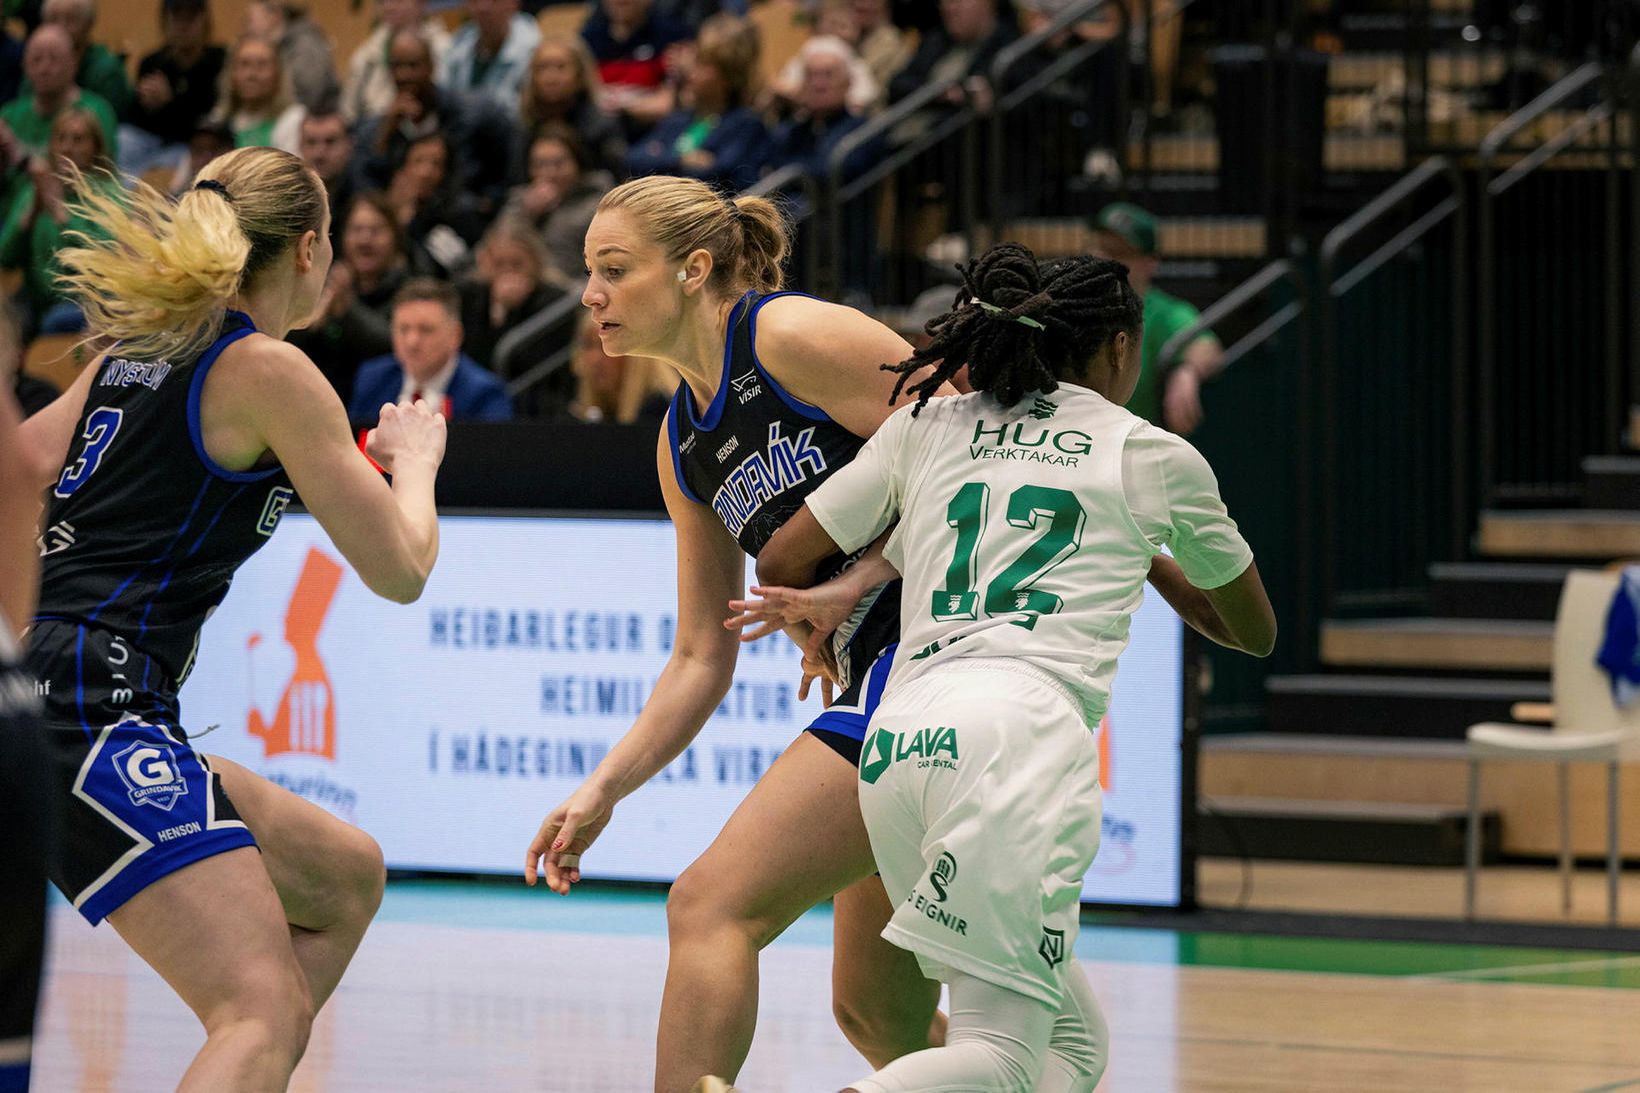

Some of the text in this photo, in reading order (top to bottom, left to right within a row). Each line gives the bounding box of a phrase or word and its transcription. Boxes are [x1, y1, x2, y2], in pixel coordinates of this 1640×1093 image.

[54, 406, 123, 498] 3
[715, 434, 739, 464] HENSON
[971, 419, 1093, 456] HUG
[931, 482, 1087, 632] 12
[895, 726, 959, 763] LAVA
[126, 747, 175, 788] G
[917, 759, 957, 771] CAR ENTAL
[156, 821, 202, 843] HENSON
